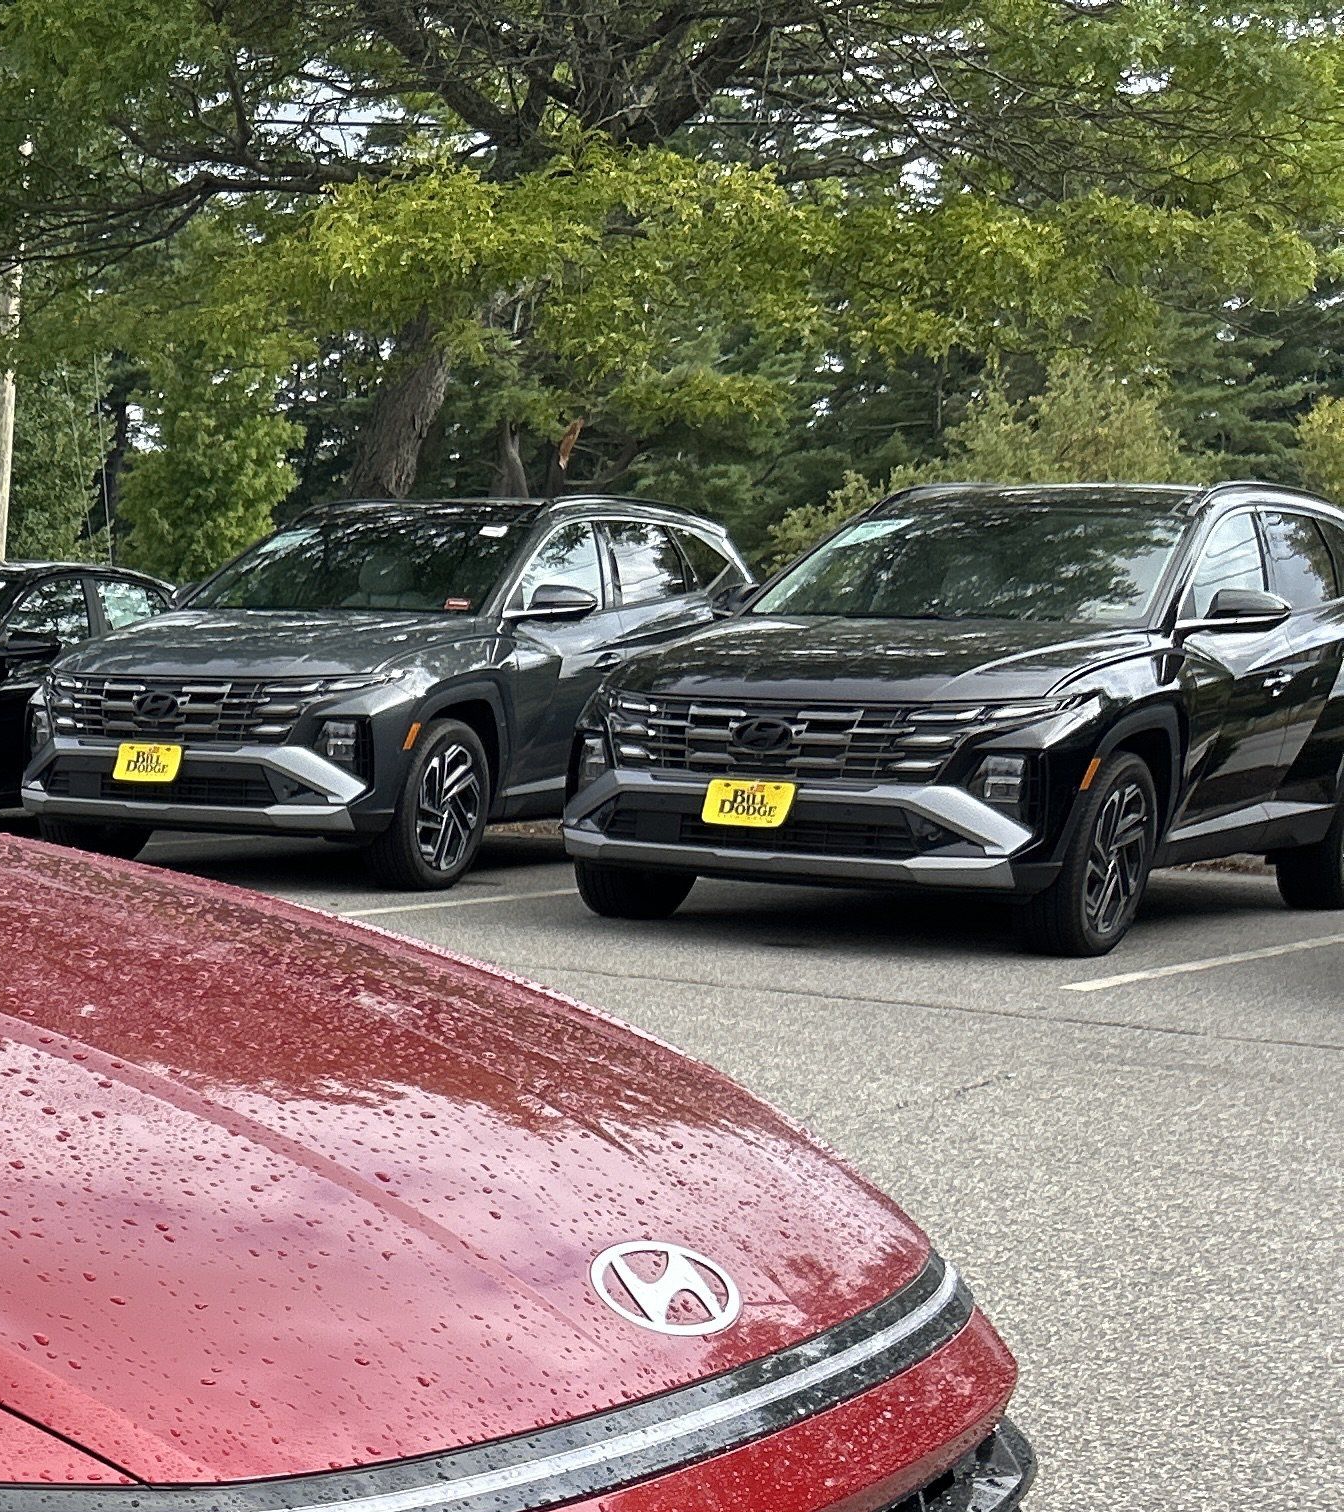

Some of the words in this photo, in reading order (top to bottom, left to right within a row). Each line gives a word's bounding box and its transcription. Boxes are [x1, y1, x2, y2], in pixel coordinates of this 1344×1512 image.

[126, 760, 169, 774] DODGE
[732, 788, 767, 805] BILL
[718, 798, 778, 818] DODGE
